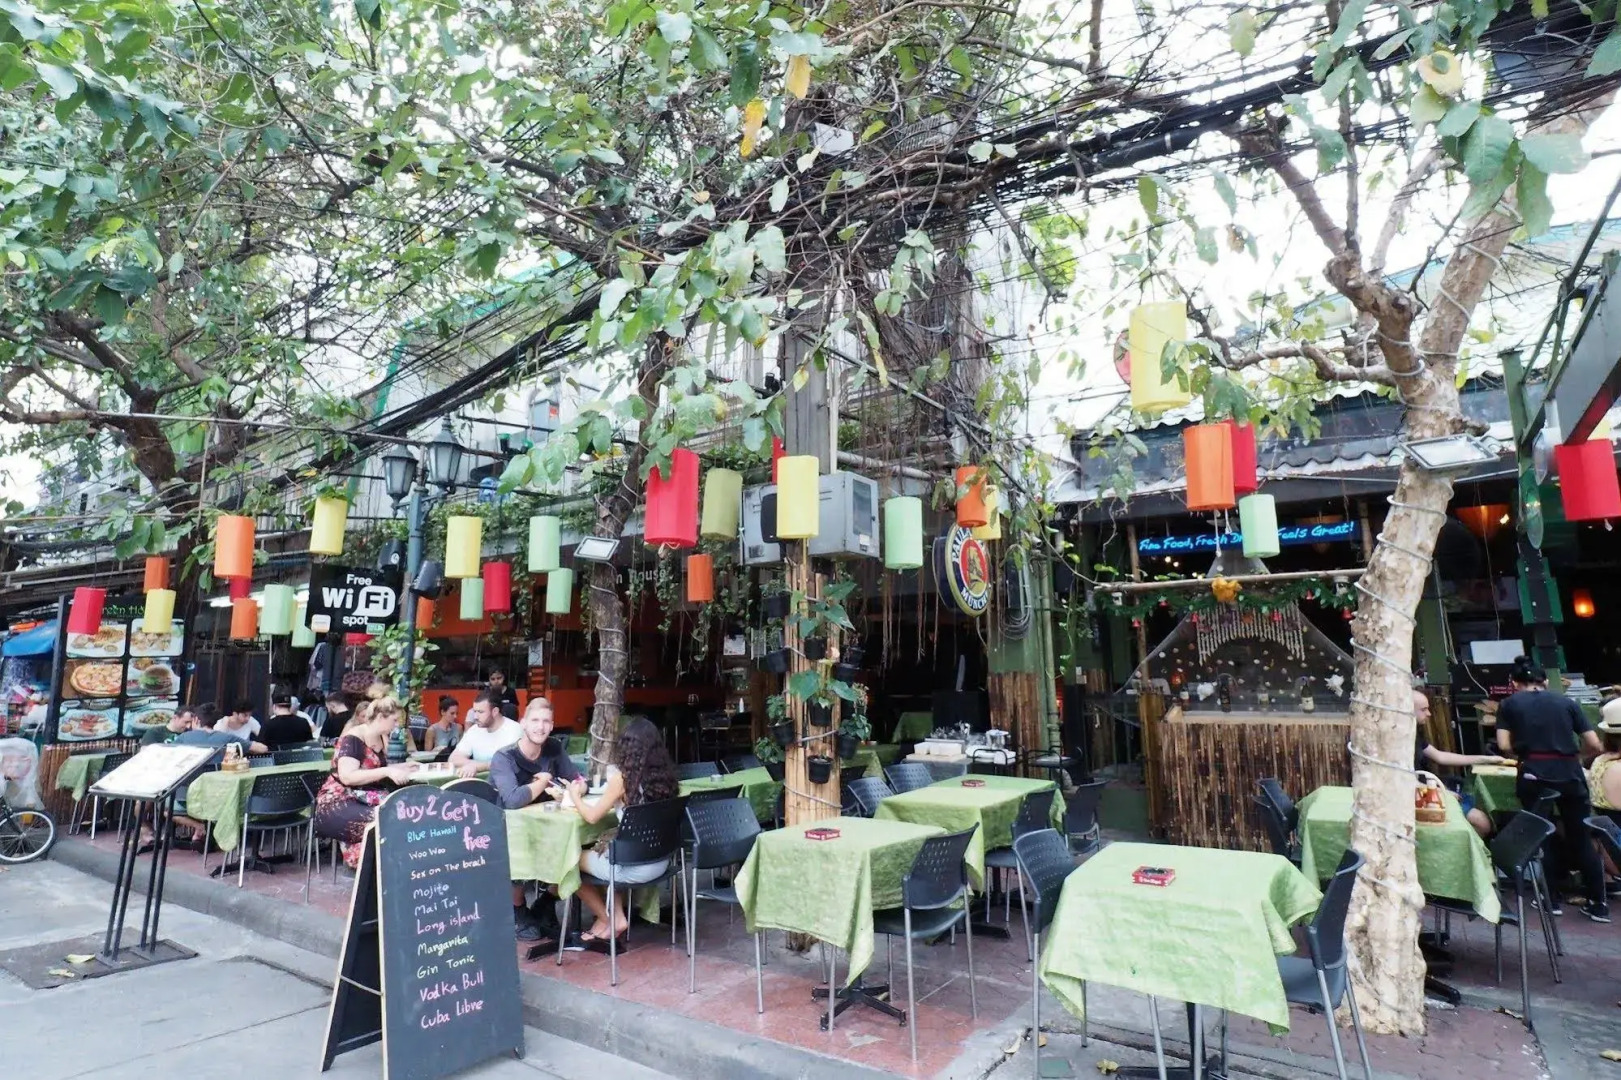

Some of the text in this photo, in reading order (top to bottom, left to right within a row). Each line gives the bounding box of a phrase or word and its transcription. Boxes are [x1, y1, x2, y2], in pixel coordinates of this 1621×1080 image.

[1311, 520, 1354, 537] Great!
[346, 573, 372, 586] Free
[102, 604, 126, 616] reen
[342, 615, 369, 627] spot
[396, 800, 424, 823] Buy
[425, 795, 437, 816] 2
[441, 799, 471, 821] Get
[407, 830, 426, 842] Blue
[463, 826, 491, 851] free
[409, 847, 446, 860] Woo Woo
[410, 870, 426, 880] Sex
[429, 867, 441, 875] on
[413, 882, 449, 899] Mojito
[414, 896, 459, 917] Mai Tai
[416, 901, 481, 935] Long island
[417, 935, 469, 956] Margarita
[416, 954, 475, 979] Gin Tonic
[462, 970, 485, 991] Bull
[420, 998, 484, 1029] Cuba Libre
